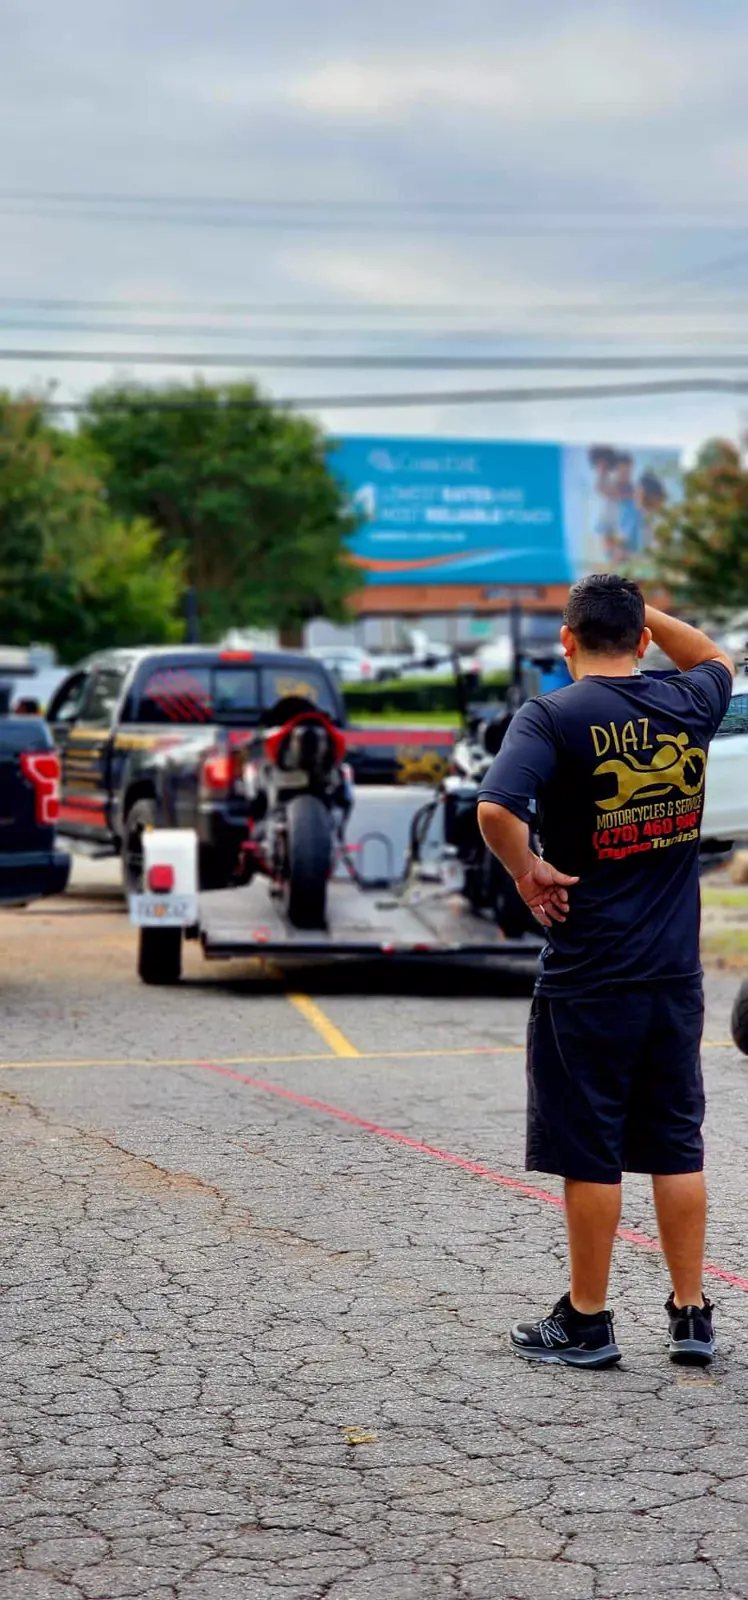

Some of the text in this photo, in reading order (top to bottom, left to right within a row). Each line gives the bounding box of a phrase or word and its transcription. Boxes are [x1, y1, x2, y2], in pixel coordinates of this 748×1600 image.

[590, 718, 653, 756] DIAZ
[596, 804, 665, 830] MOTORCYCLES
[667, 802, 674, 816] &
[592, 824, 639, 849] (470)
[642, 818, 673, 836] 460
